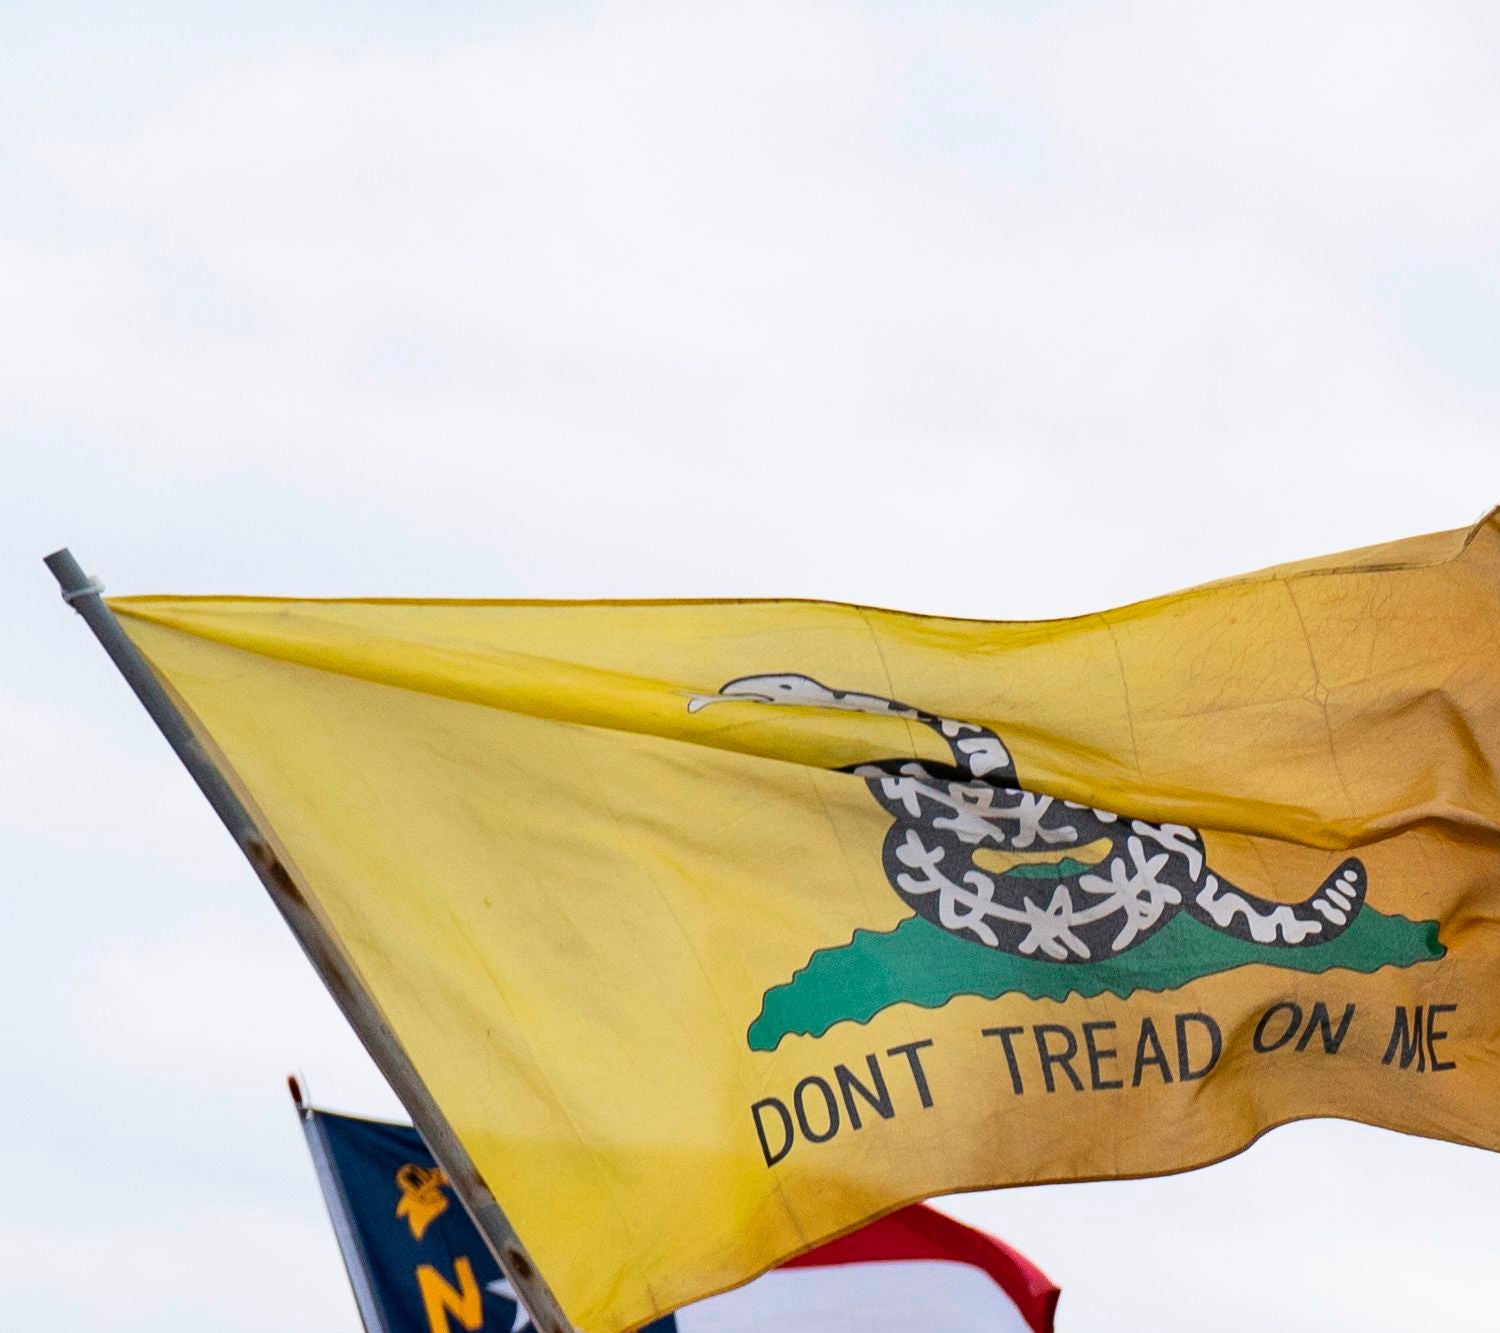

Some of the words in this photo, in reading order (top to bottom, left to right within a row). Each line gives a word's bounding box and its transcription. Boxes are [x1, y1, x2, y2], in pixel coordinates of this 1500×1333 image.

[750, 1038, 934, 1168] DONT
[982, 1011, 1222, 1095] TREAD
[1253, 1001, 1356, 1055] ON
[1380, 1002, 1459, 1074] ME
